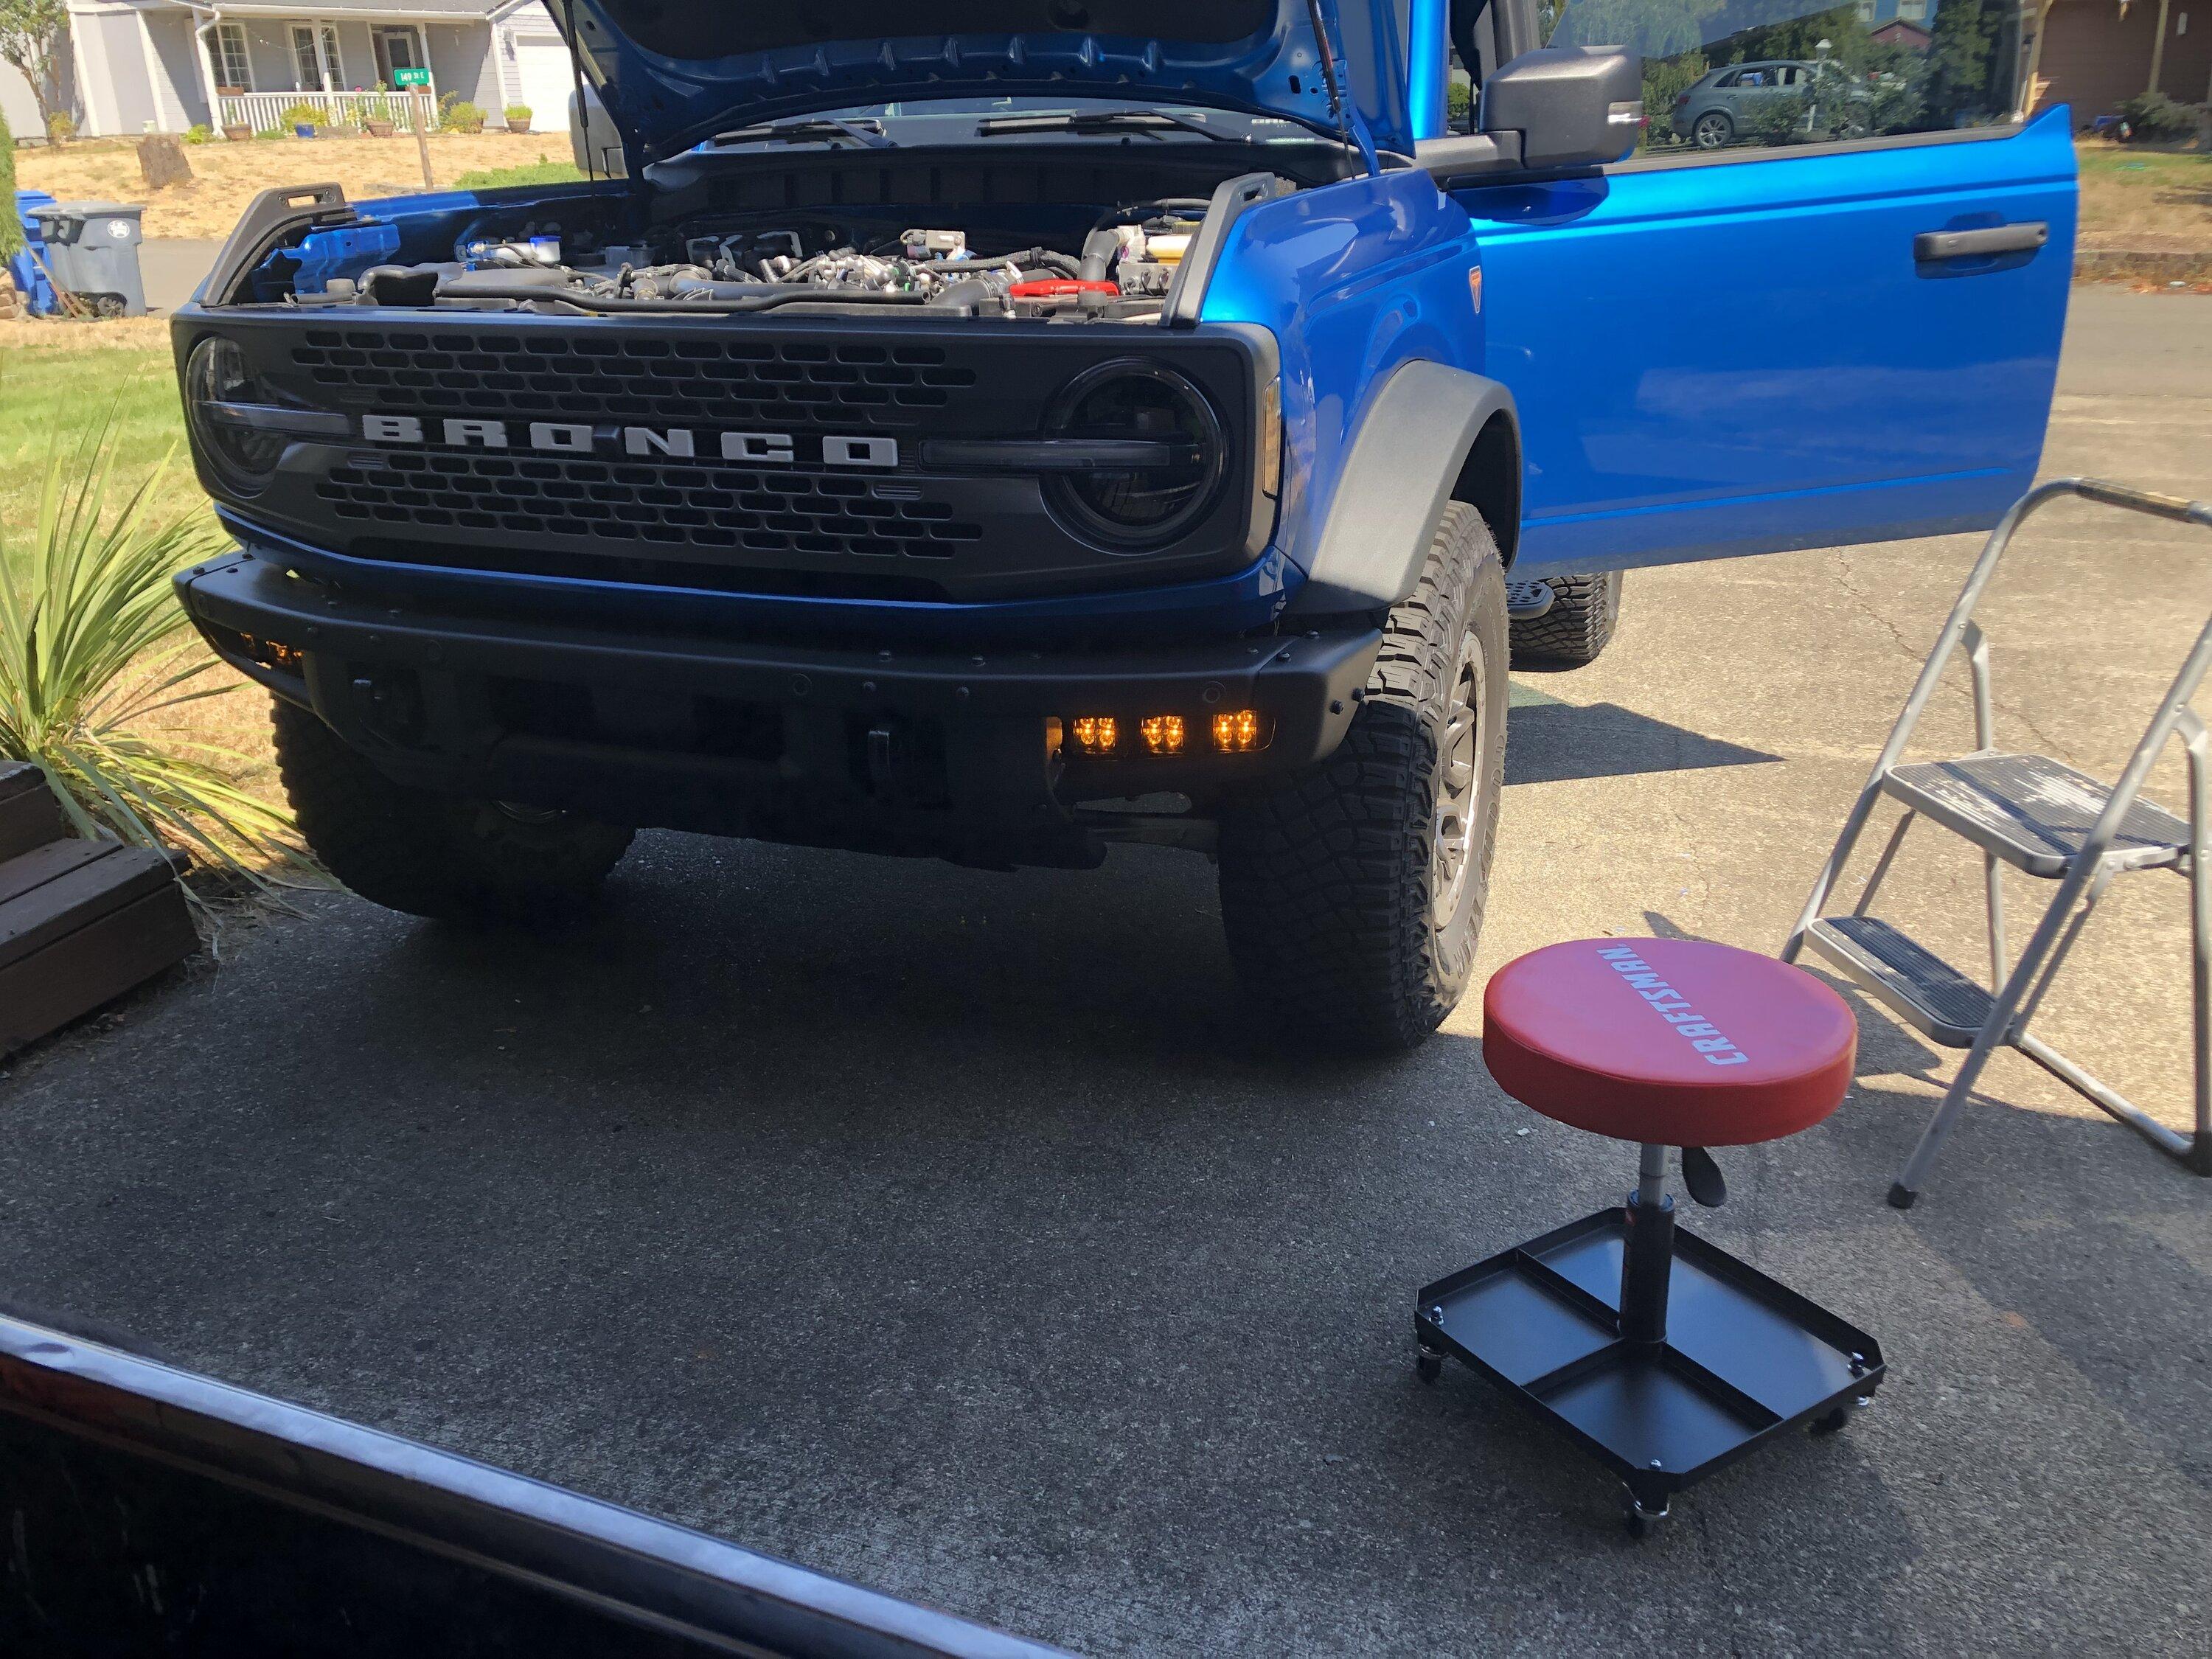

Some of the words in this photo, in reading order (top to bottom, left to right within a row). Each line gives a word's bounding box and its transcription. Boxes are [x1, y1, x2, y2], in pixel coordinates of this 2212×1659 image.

[400, 72, 412, 82] 149
[362, 414, 898, 466] BRONCO
[1596, 945, 1749, 1065] CRAFTSMAN
